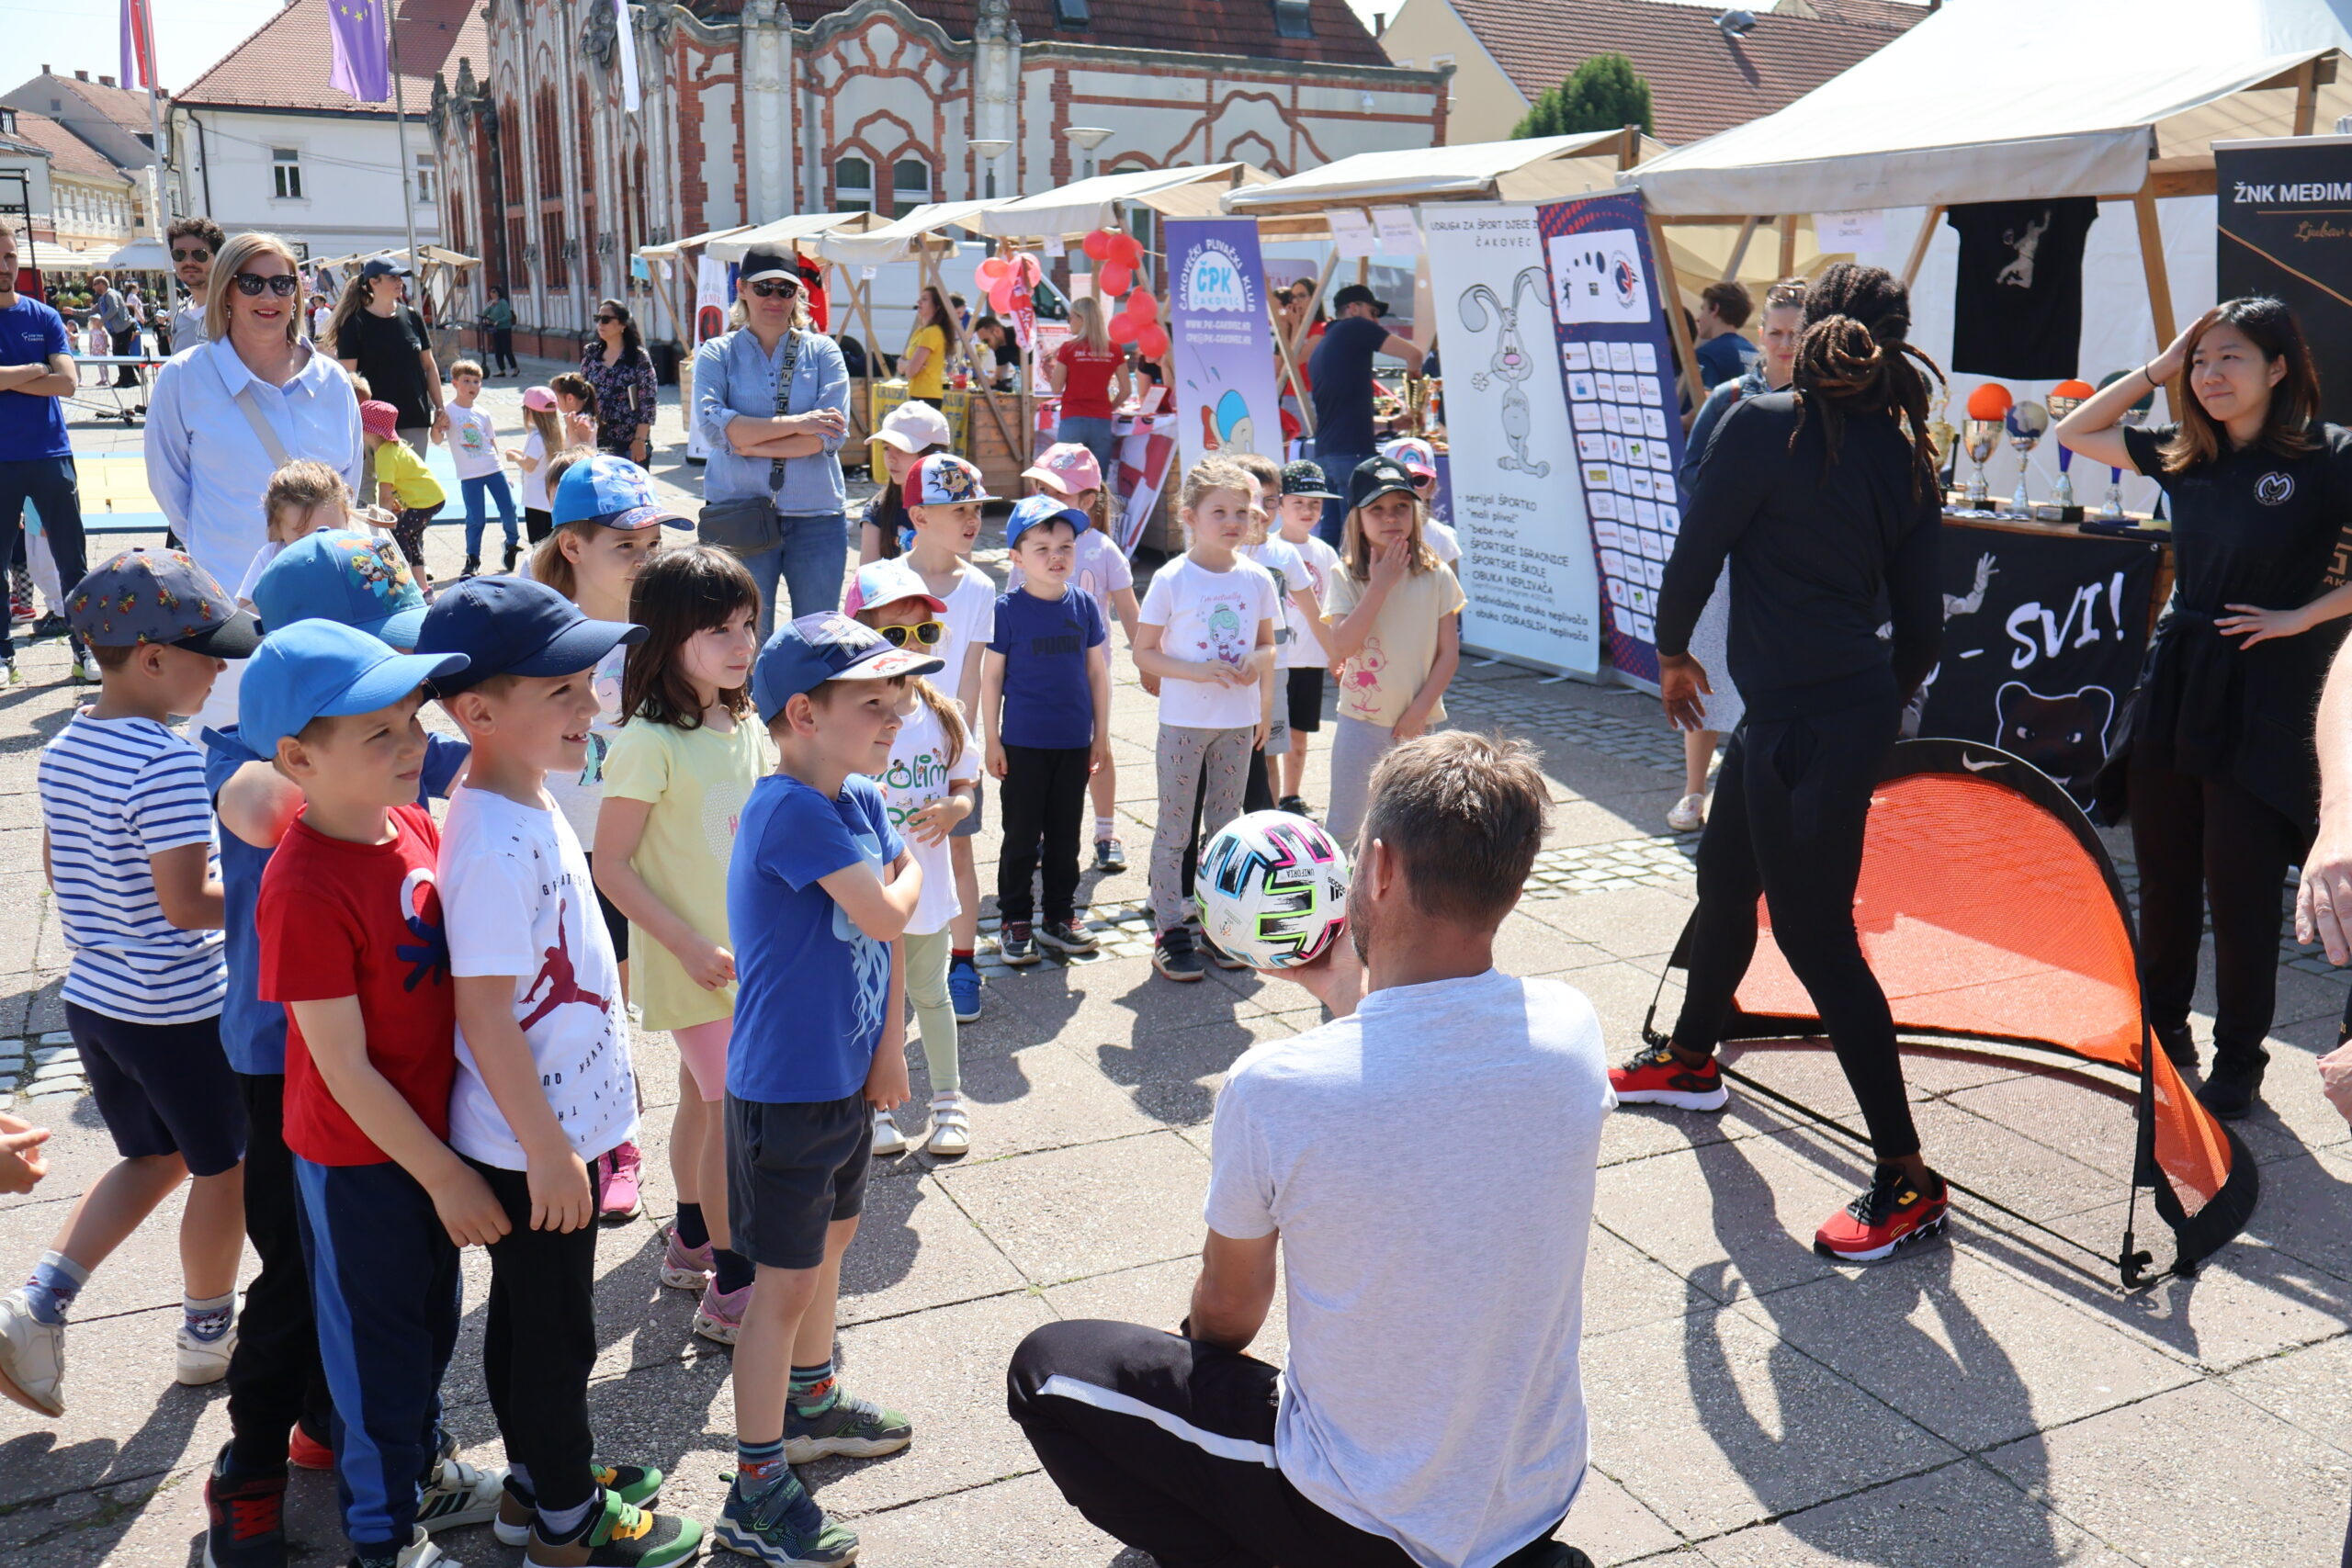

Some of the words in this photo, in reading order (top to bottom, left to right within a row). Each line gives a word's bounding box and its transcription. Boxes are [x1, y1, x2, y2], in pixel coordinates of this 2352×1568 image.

[2233, 181, 2276, 203] ŽNK
[1430, 220, 1460, 231] UDRUGA
[1463, 221, 1475, 231] ZA
[1476, 218, 1502, 230] ŠPORT
[1505, 220, 1531, 230] DJECE
[1475, 236, 1532, 247] ČAKOVEC
[1179, 243, 1203, 310] ČAKOVEČKI
[1204, 238, 1243, 270] PLIVAČKI
[1241, 275, 1257, 312] KLUB
[1197, 260, 1231, 294] ČPK
[1464, 494, 1495, 506] serijal
[1498, 492, 1537, 512] ŠPORTKO
[1470, 537, 1516, 556] ŠPORTSKE
[1519, 547, 1569, 568] IGRAONICE
[1472, 553, 1517, 571] ŠPORTSKE
[1521, 560, 1547, 579] ŠKOLE
[1472, 570, 1502, 583] OBUKA
[1506, 576, 1554, 594] NEPLIVAČA
[1475, 608, 1499, 622] obuka
[1501, 614, 1547, 632] ODRASLIH
[1549, 627, 1589, 642] neplivača
[1522, 603, 1545, 617] obuka
[1548, 610, 1589, 626] neplivača
[2006, 571, 2125, 671] SVI!
[1032, 634, 1081, 656] PUMA
[876, 754, 948, 790] olim
[1286, 868, 1315, 879] UNIFORIA
